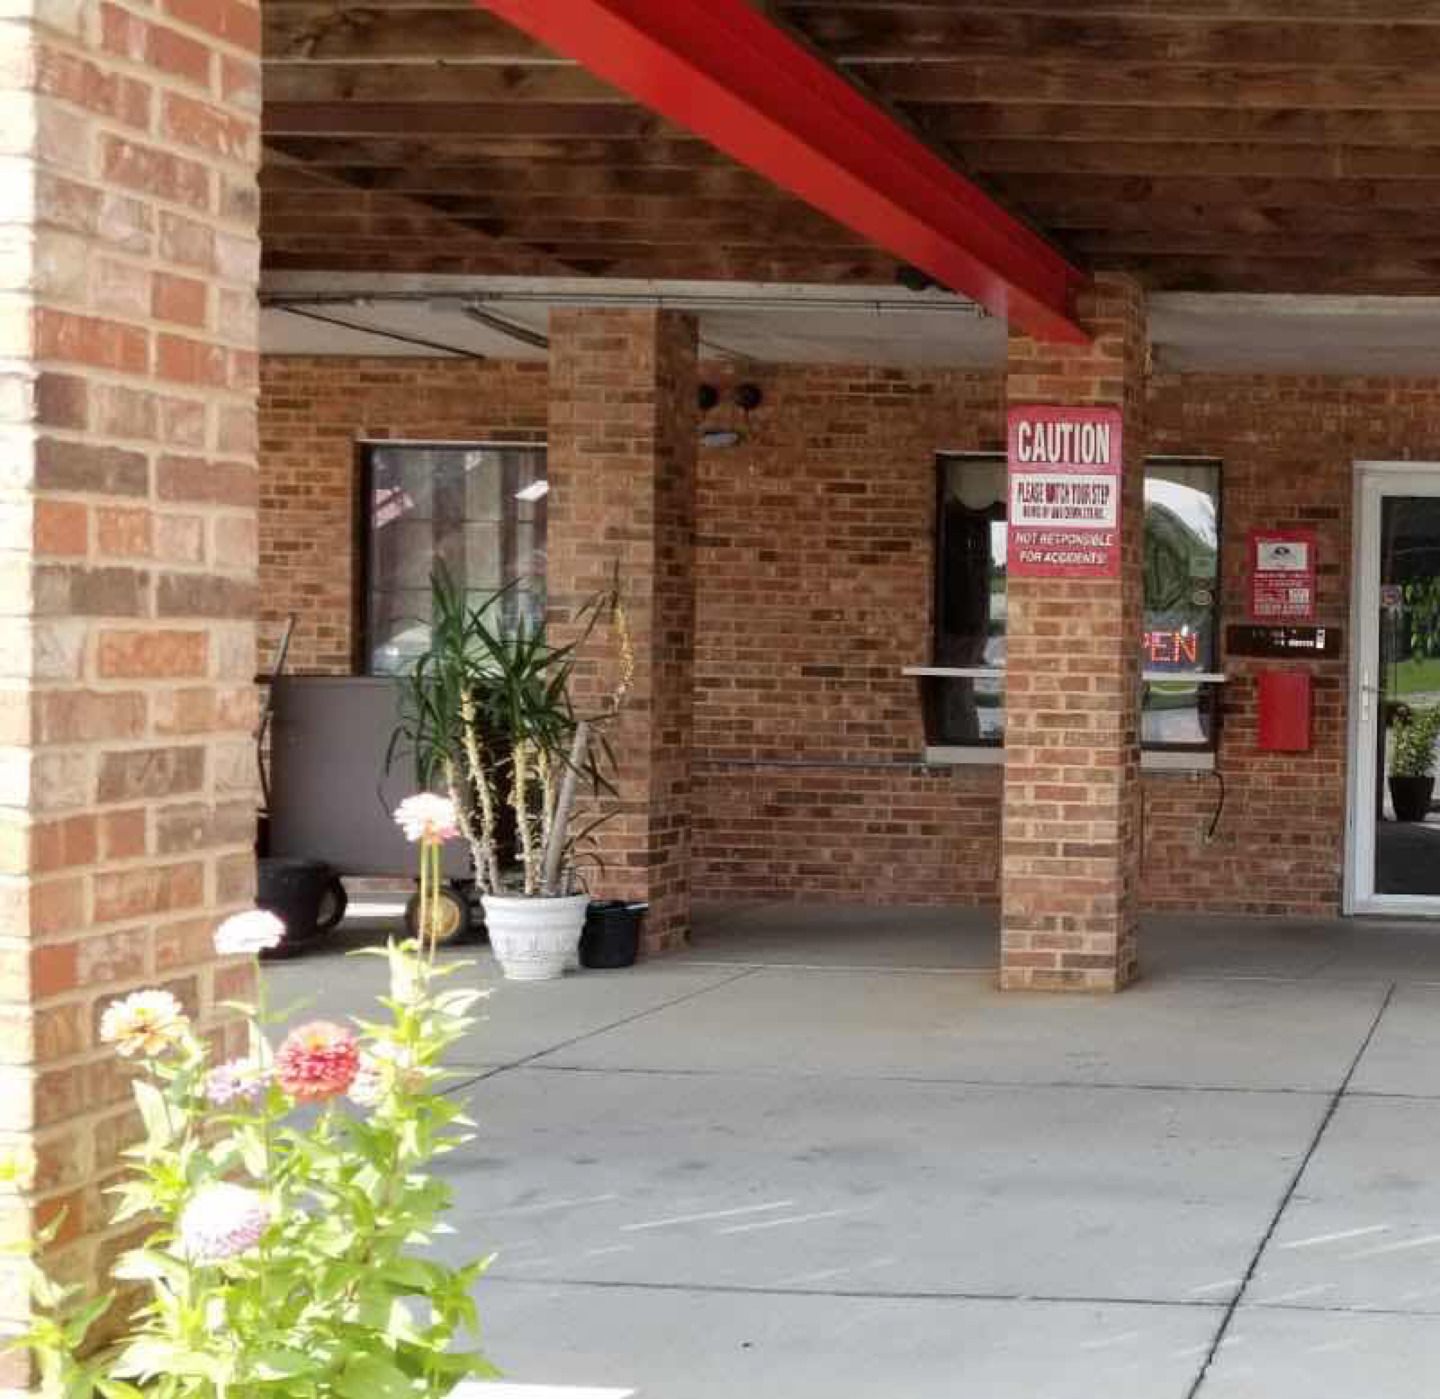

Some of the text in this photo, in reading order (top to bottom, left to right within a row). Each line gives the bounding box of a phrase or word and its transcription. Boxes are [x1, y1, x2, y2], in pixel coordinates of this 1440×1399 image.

[1018, 420, 1110, 464] CAUTION
[1017, 482, 1044, 503] PLEASE
[1091, 483, 1110, 505] STEP
[1014, 531, 1037, 546] NOT
[1020, 550, 1042, 563] FOR
[1142, 629, 1197, 663] EN
